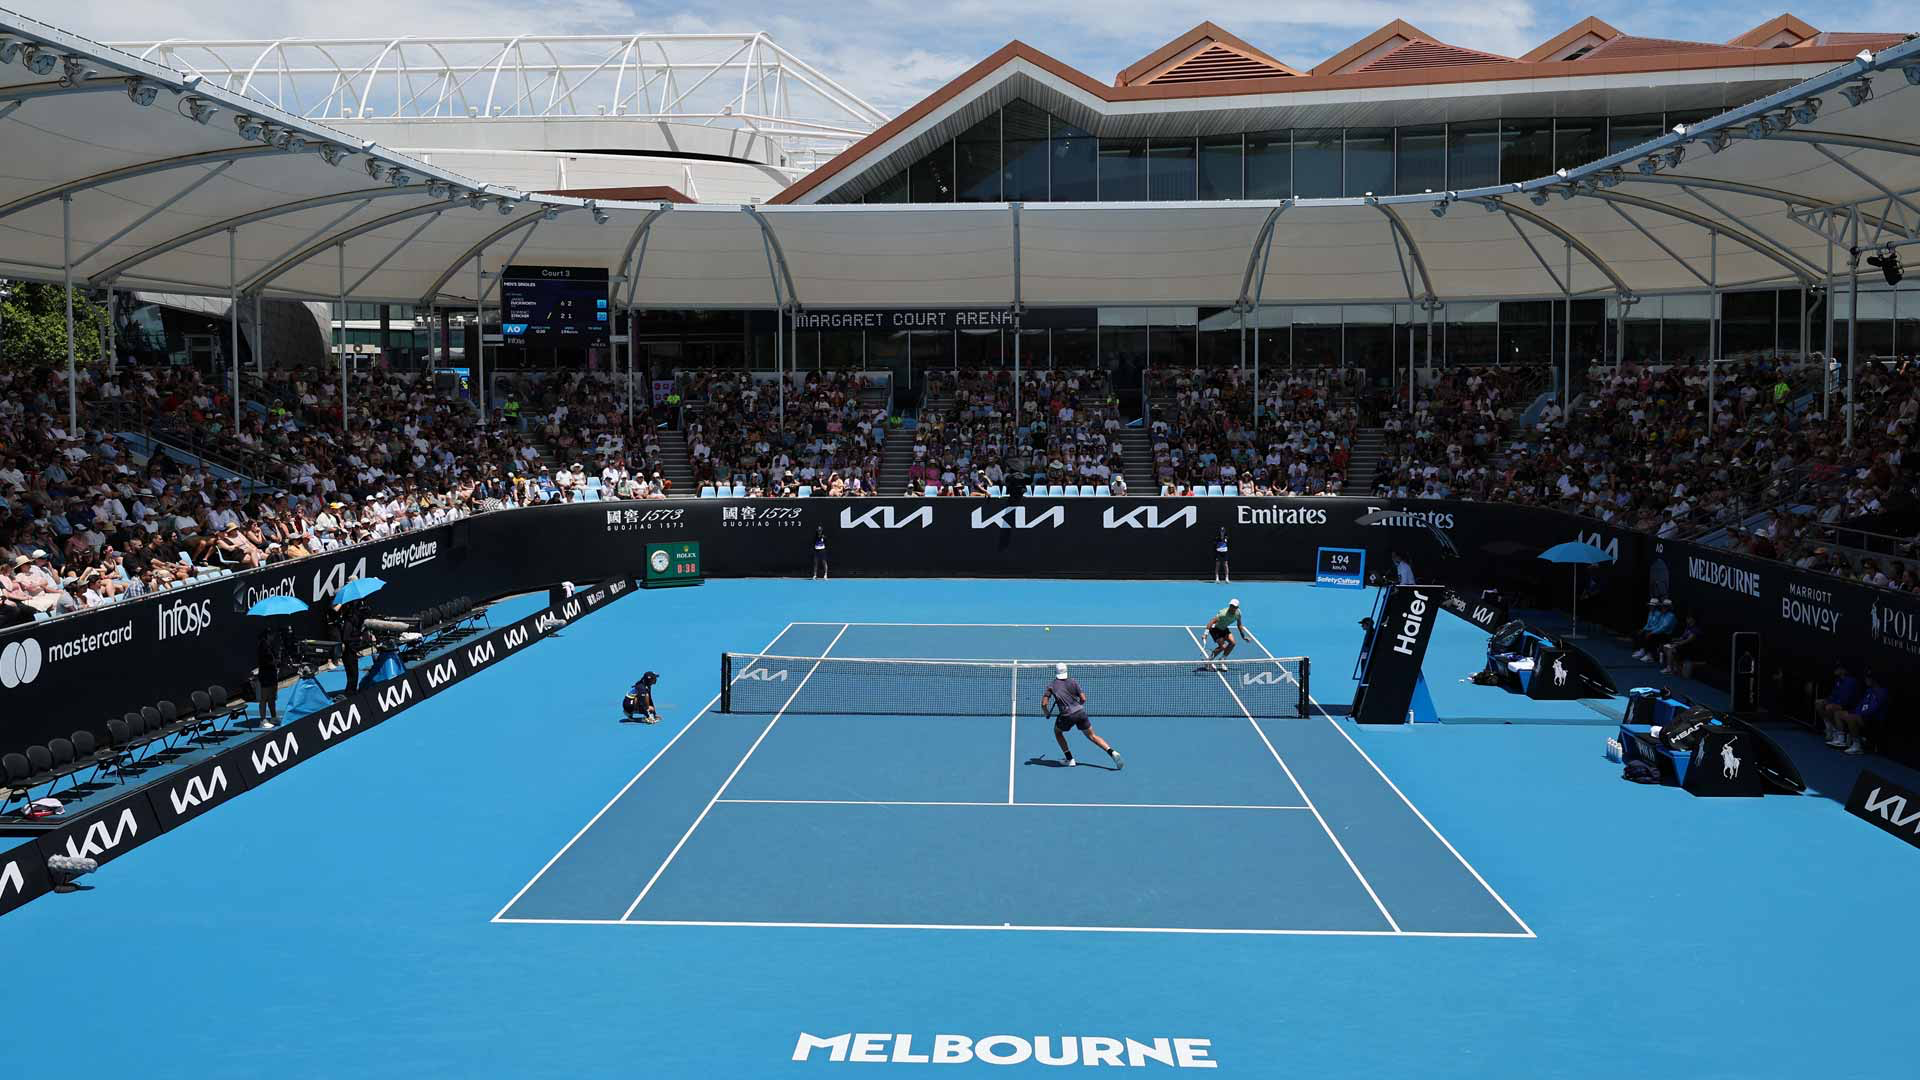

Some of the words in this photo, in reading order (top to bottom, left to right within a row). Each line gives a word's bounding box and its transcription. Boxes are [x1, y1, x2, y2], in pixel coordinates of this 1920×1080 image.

[796, 313, 883, 327] MARGARET
[893, 312, 946, 325] COURT
[955, 311, 1013, 324] ARENA
[607, 523, 652, 531] GUOJIAO
[840, 505, 932, 528] KIA
[971, 505, 1064, 528] KIA
[1103, 505, 1197, 528] KIA
[1237, 504, 1327, 525] Emirates
[381, 541, 438, 570] SafetyCulture
[1331, 555, 1349, 564] 194
[1318, 576, 1360, 585] SafetyCulture
[1688, 556, 1760, 598] MELBOURNE
[247, 576, 296, 610] CyberCX
[1789, 583, 1832, 604] MARRIOTT
[158, 598, 211, 641] Infosys
[1394, 590, 1428, 656] Haier
[1782, 597, 1840, 633] BONVOY
[49, 620, 132, 663] mastercard
[503, 624, 529, 650] KIA
[468, 640, 495, 667] KIA
[426, 658, 457, 688] KIA
[739, 668, 788, 681] KIA
[1243, 671, 1293, 685] KIA
[377, 679, 413, 713] KIA
[317, 703, 361, 741] KIA
[1671, 721, 1703, 744] HEAD
[251, 731, 299, 774] KIA
[170, 765, 227, 815] KIA
[66, 808, 138, 859] KIA
[792, 1032, 1218, 1068] MELBOURNE
